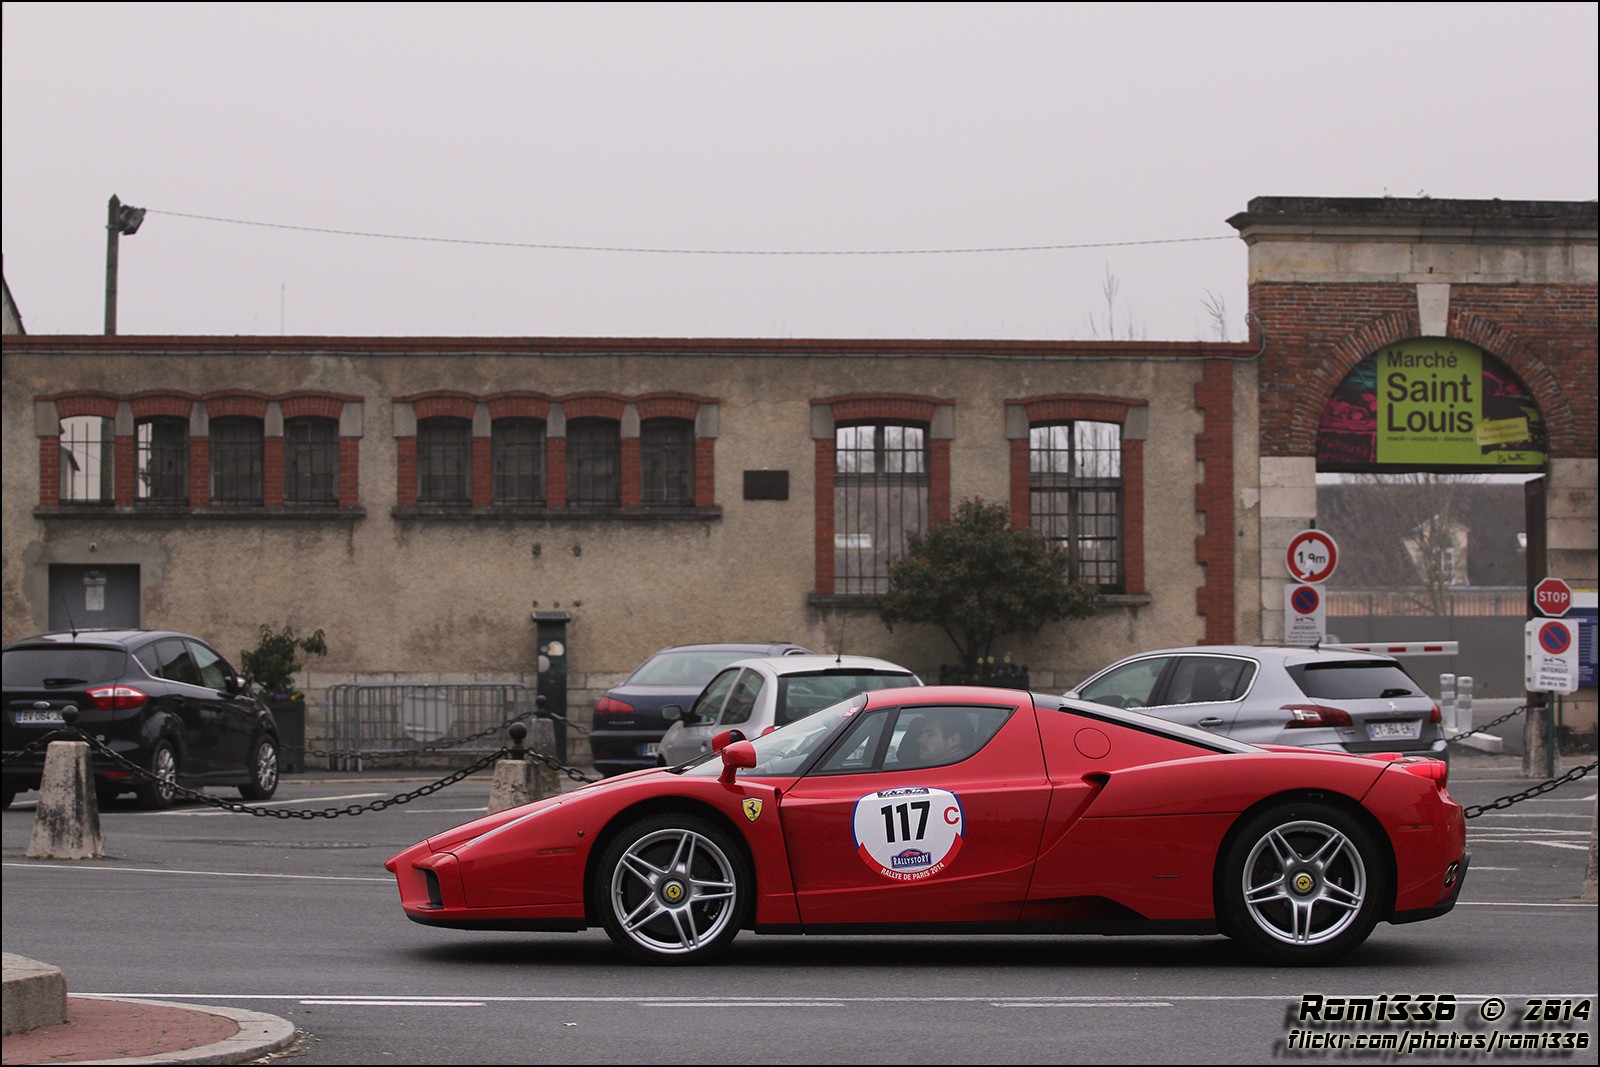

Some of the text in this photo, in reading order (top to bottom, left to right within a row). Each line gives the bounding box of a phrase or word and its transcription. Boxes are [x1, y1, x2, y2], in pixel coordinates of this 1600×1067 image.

[1387, 350, 1458, 368] Marché
[1386, 373, 1473, 403] Saint
[1387, 403, 1474, 433] Louis
[1539, 591, 1569, 603] STOP
[881, 801, 960, 843] 117 C
[893, 853, 930, 866] RALLYSTORY
[881, 862, 945, 881] RALLYE DE PARIS 2014
